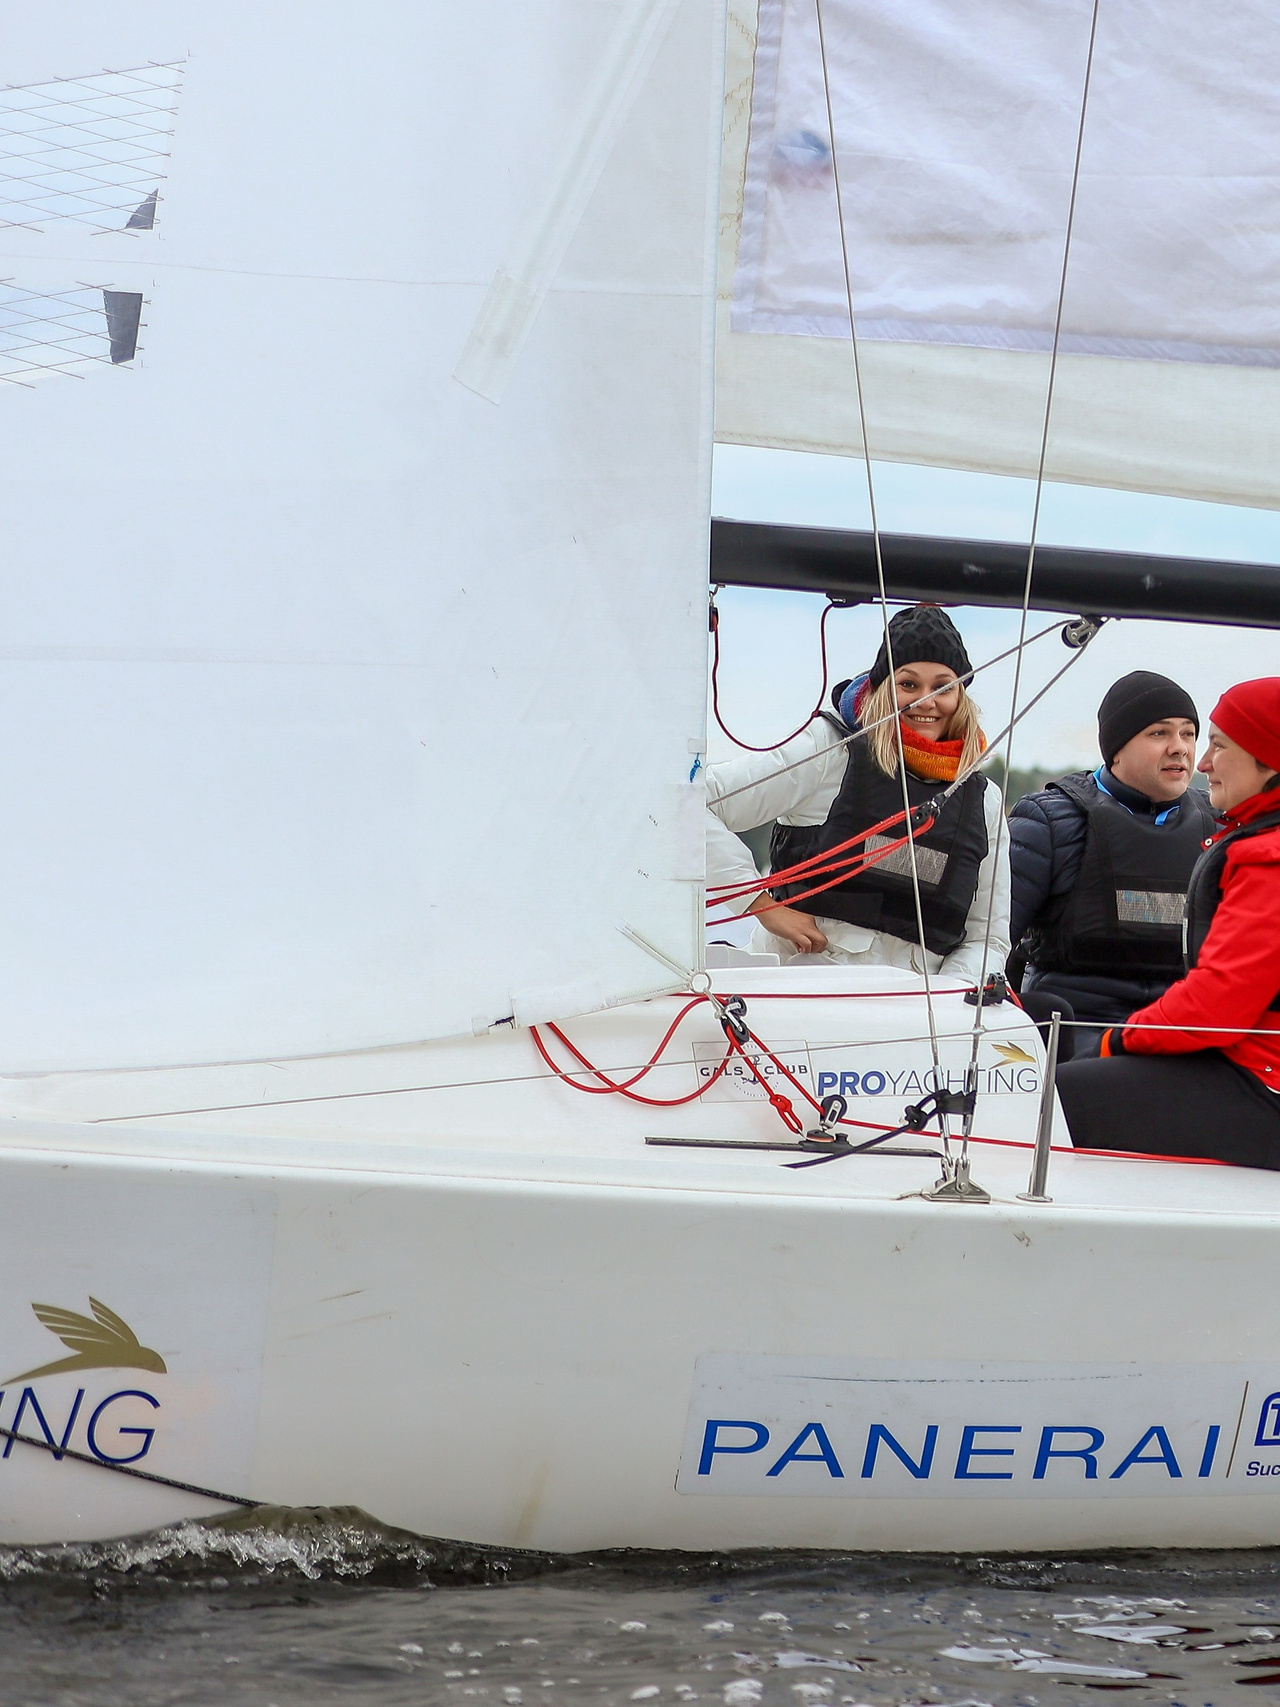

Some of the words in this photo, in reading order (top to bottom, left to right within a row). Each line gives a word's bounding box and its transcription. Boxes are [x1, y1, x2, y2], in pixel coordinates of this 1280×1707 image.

[764, 1065, 808, 1075] CLUB
[0, 1386, 161, 1464] NG
[697, 1419, 1221, 1480] PANERAI
